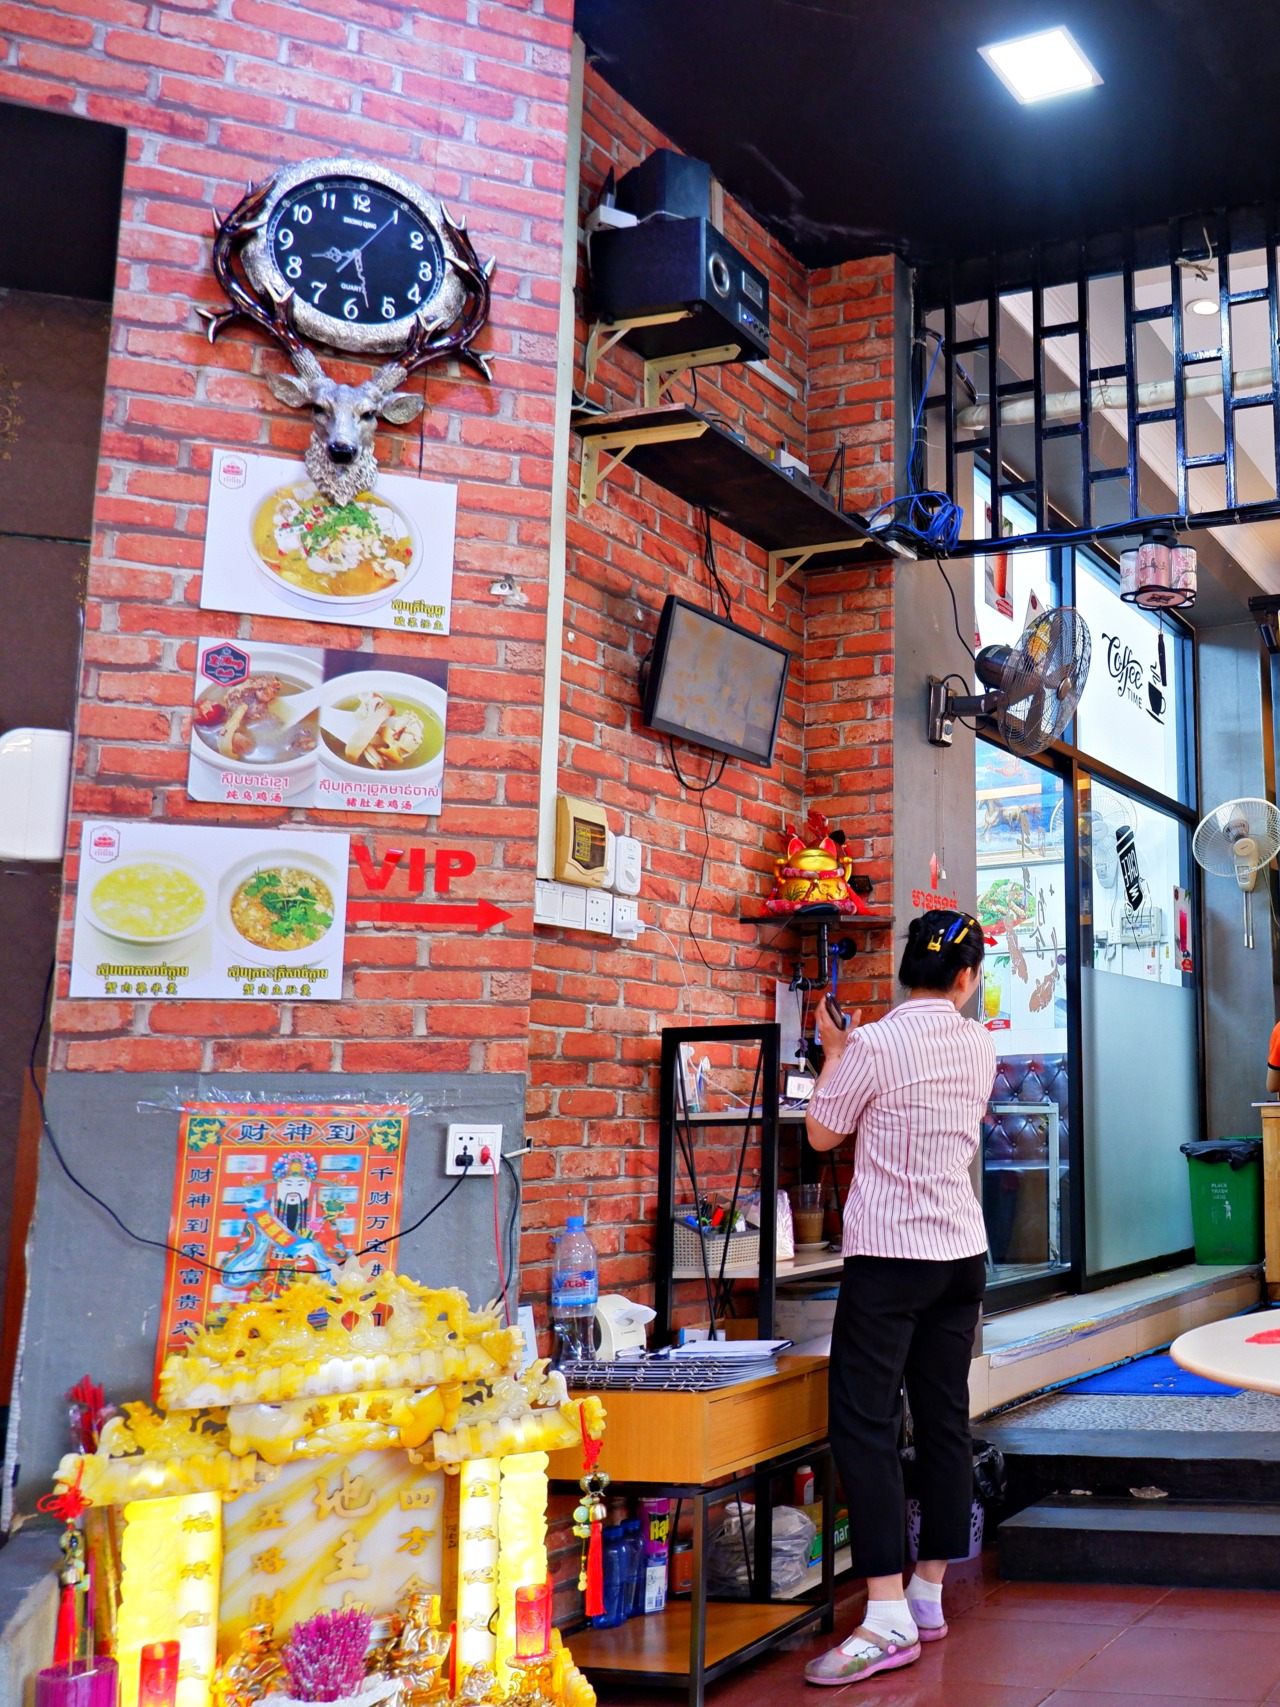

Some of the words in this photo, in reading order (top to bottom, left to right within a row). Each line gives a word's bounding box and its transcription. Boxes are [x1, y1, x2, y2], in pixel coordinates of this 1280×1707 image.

[321, 192, 336, 210] 11
[353, 194, 371, 213] 12
[293, 204, 312, 225] 10
[393, 209, 399, 225] 1
[278, 228, 294, 250] 9
[409, 231, 424, 251] 2
[286, 256, 302, 279] 8
[418, 261, 432, 281] 3
[311, 281, 328, 304] 7
[407, 282, 421, 304] 4
[343, 298, 359, 319] 6
[382, 296, 395, 319] 5
[1101, 632, 1144, 697] Coffee
[1127, 687, 1142, 709] TIME
[351, 845, 477, 893] VIP
[237, 1123, 356, 1142] 财神到
